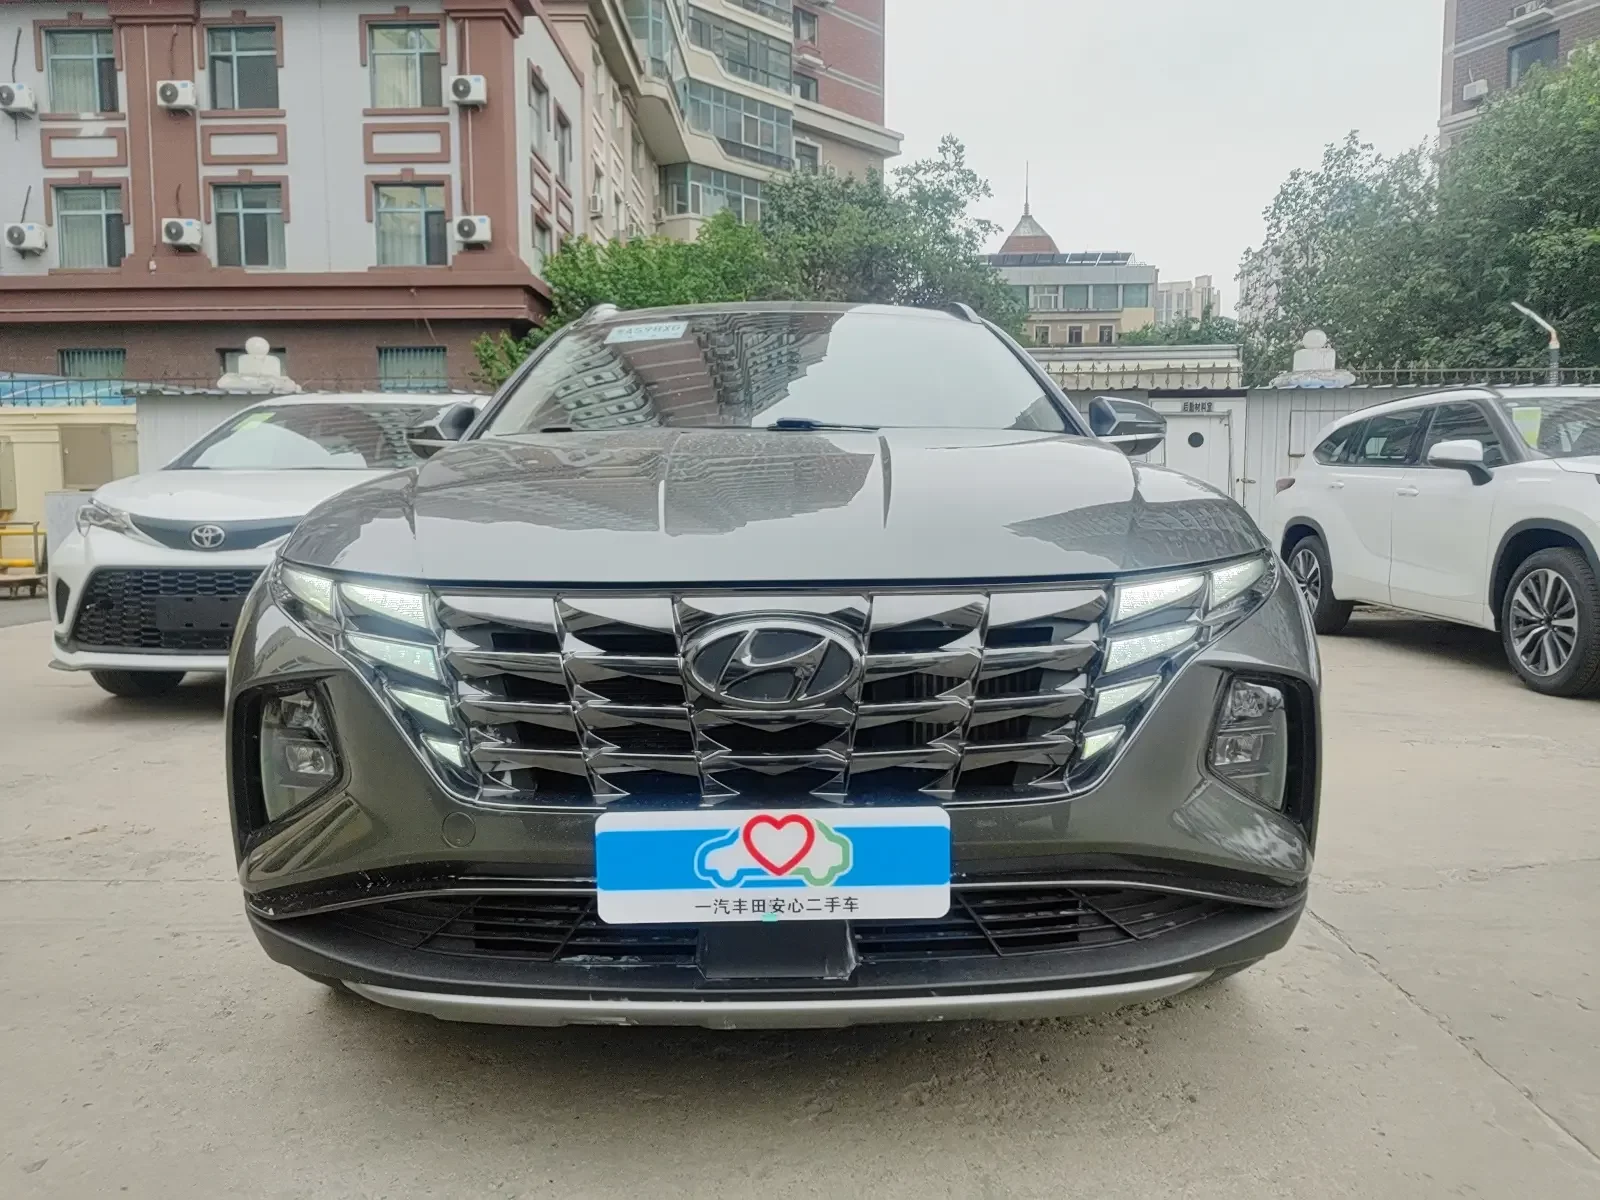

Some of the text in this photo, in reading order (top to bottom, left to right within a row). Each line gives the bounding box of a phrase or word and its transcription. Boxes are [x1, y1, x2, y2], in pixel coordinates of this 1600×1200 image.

[695, 896, 859, 915] 一汽丰田安心二手车
